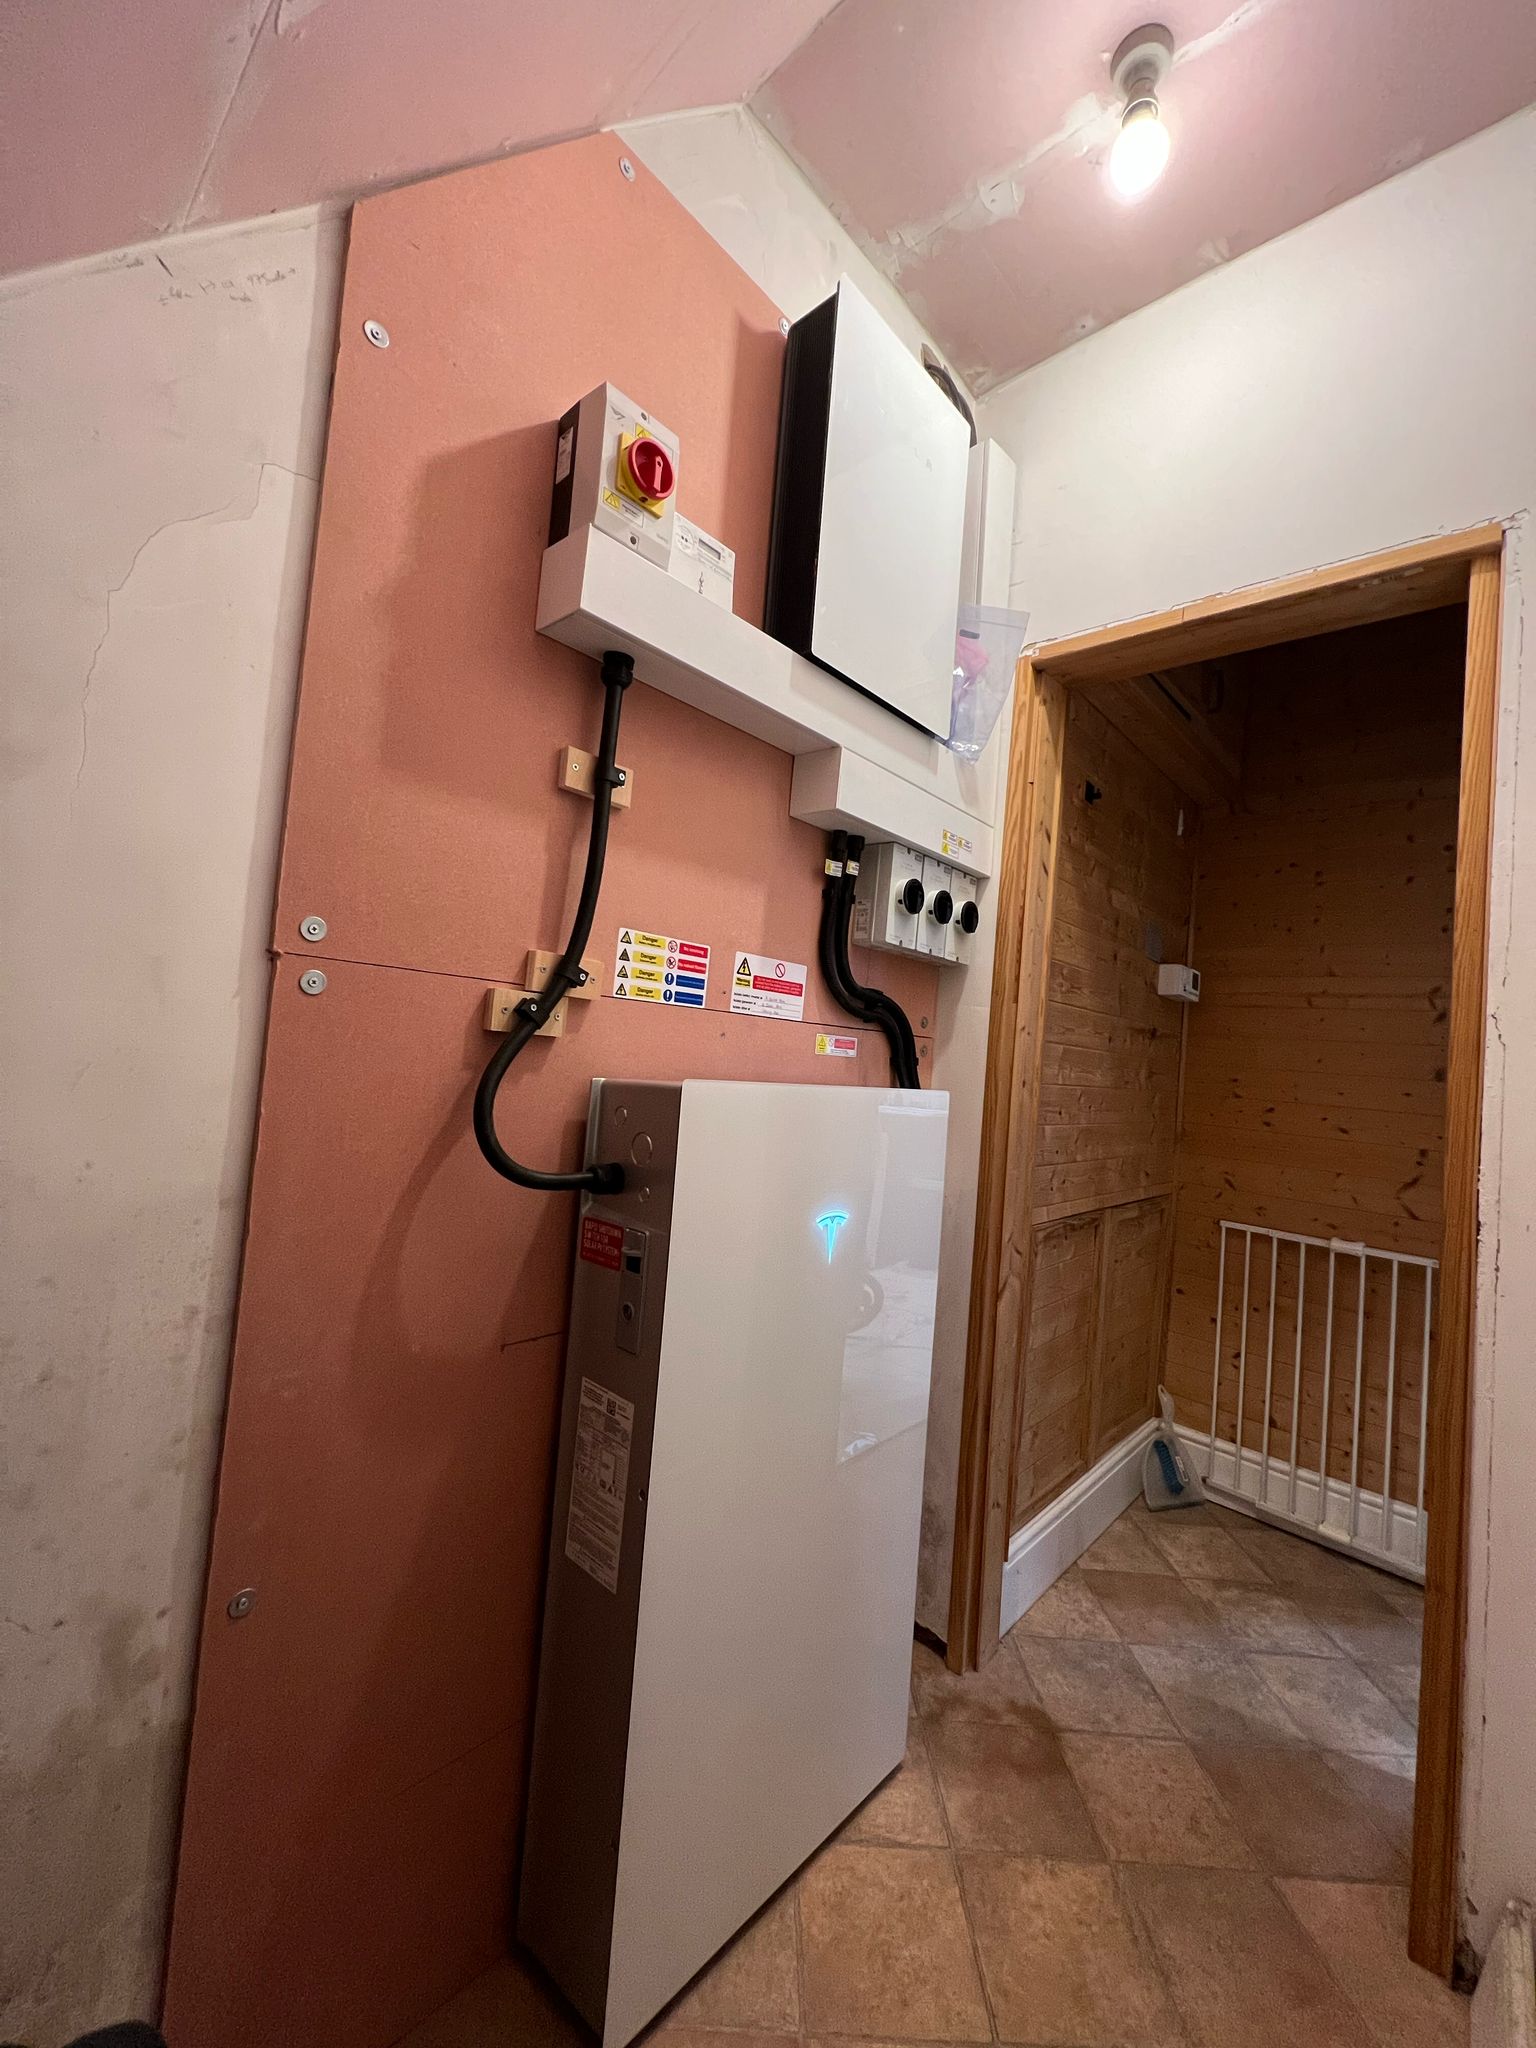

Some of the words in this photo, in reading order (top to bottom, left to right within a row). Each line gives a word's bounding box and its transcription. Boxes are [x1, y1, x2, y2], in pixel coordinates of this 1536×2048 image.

[642, 935, 658, 943] Danger
[640, 952, 656, 960] Danger
[639, 969, 655, 977] Danger
